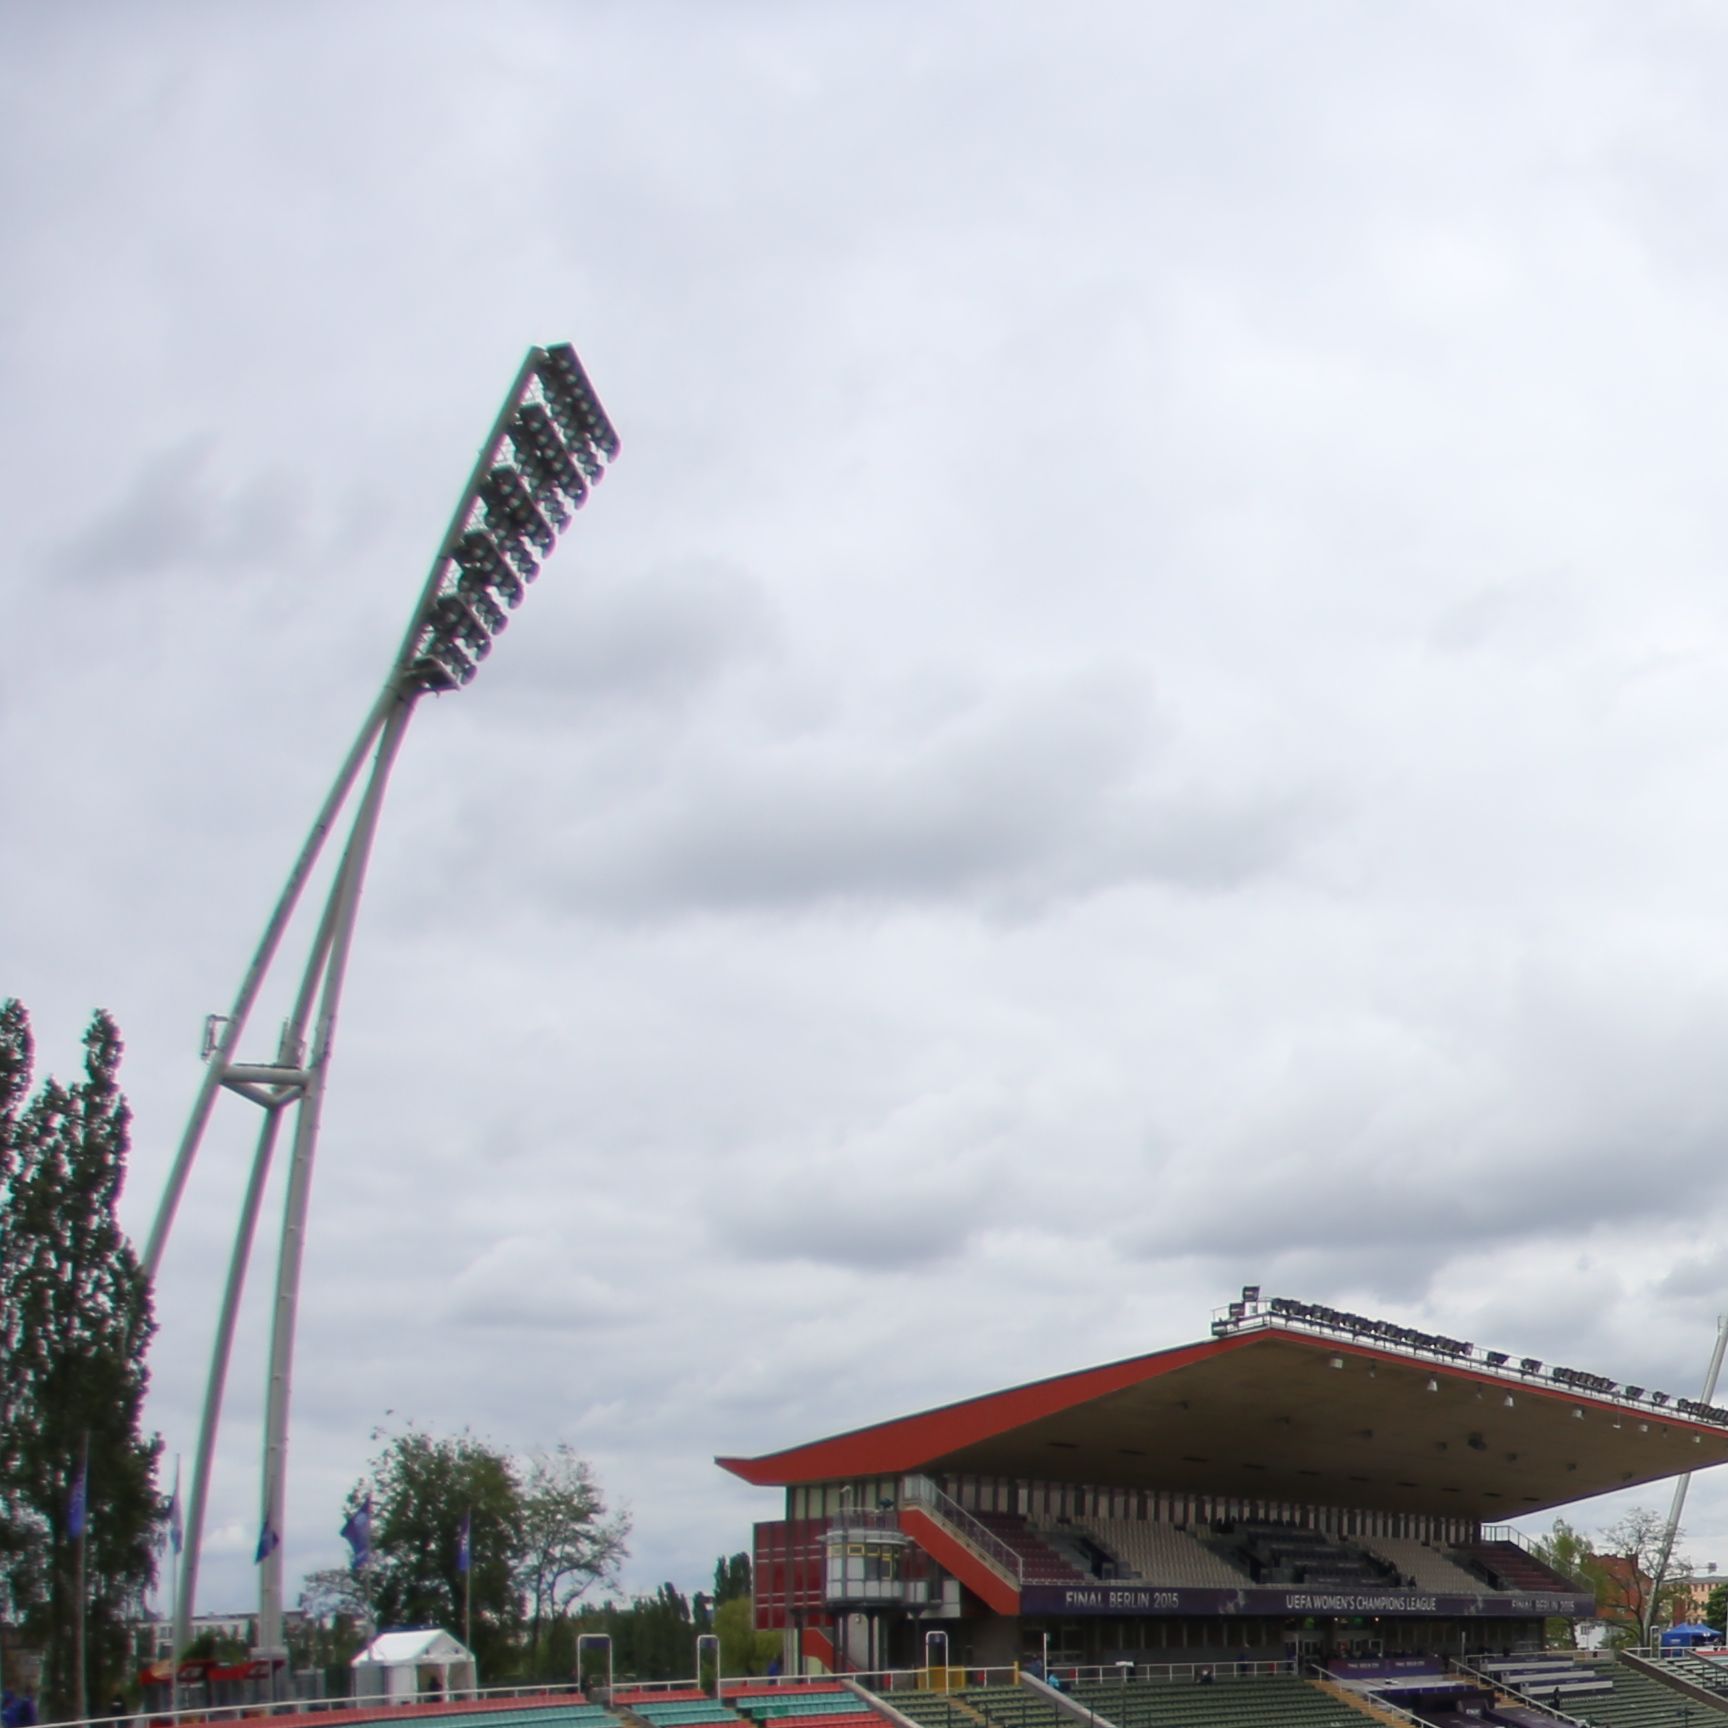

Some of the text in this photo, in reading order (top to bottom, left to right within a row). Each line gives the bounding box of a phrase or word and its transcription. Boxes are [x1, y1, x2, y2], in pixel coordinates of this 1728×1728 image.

[1065, 1592, 1179, 1608] FINAL BERLIN 2015
[1286, 1595, 1437, 1611] UEFA WOMEN'S CHAMPIONS LEAGUE
